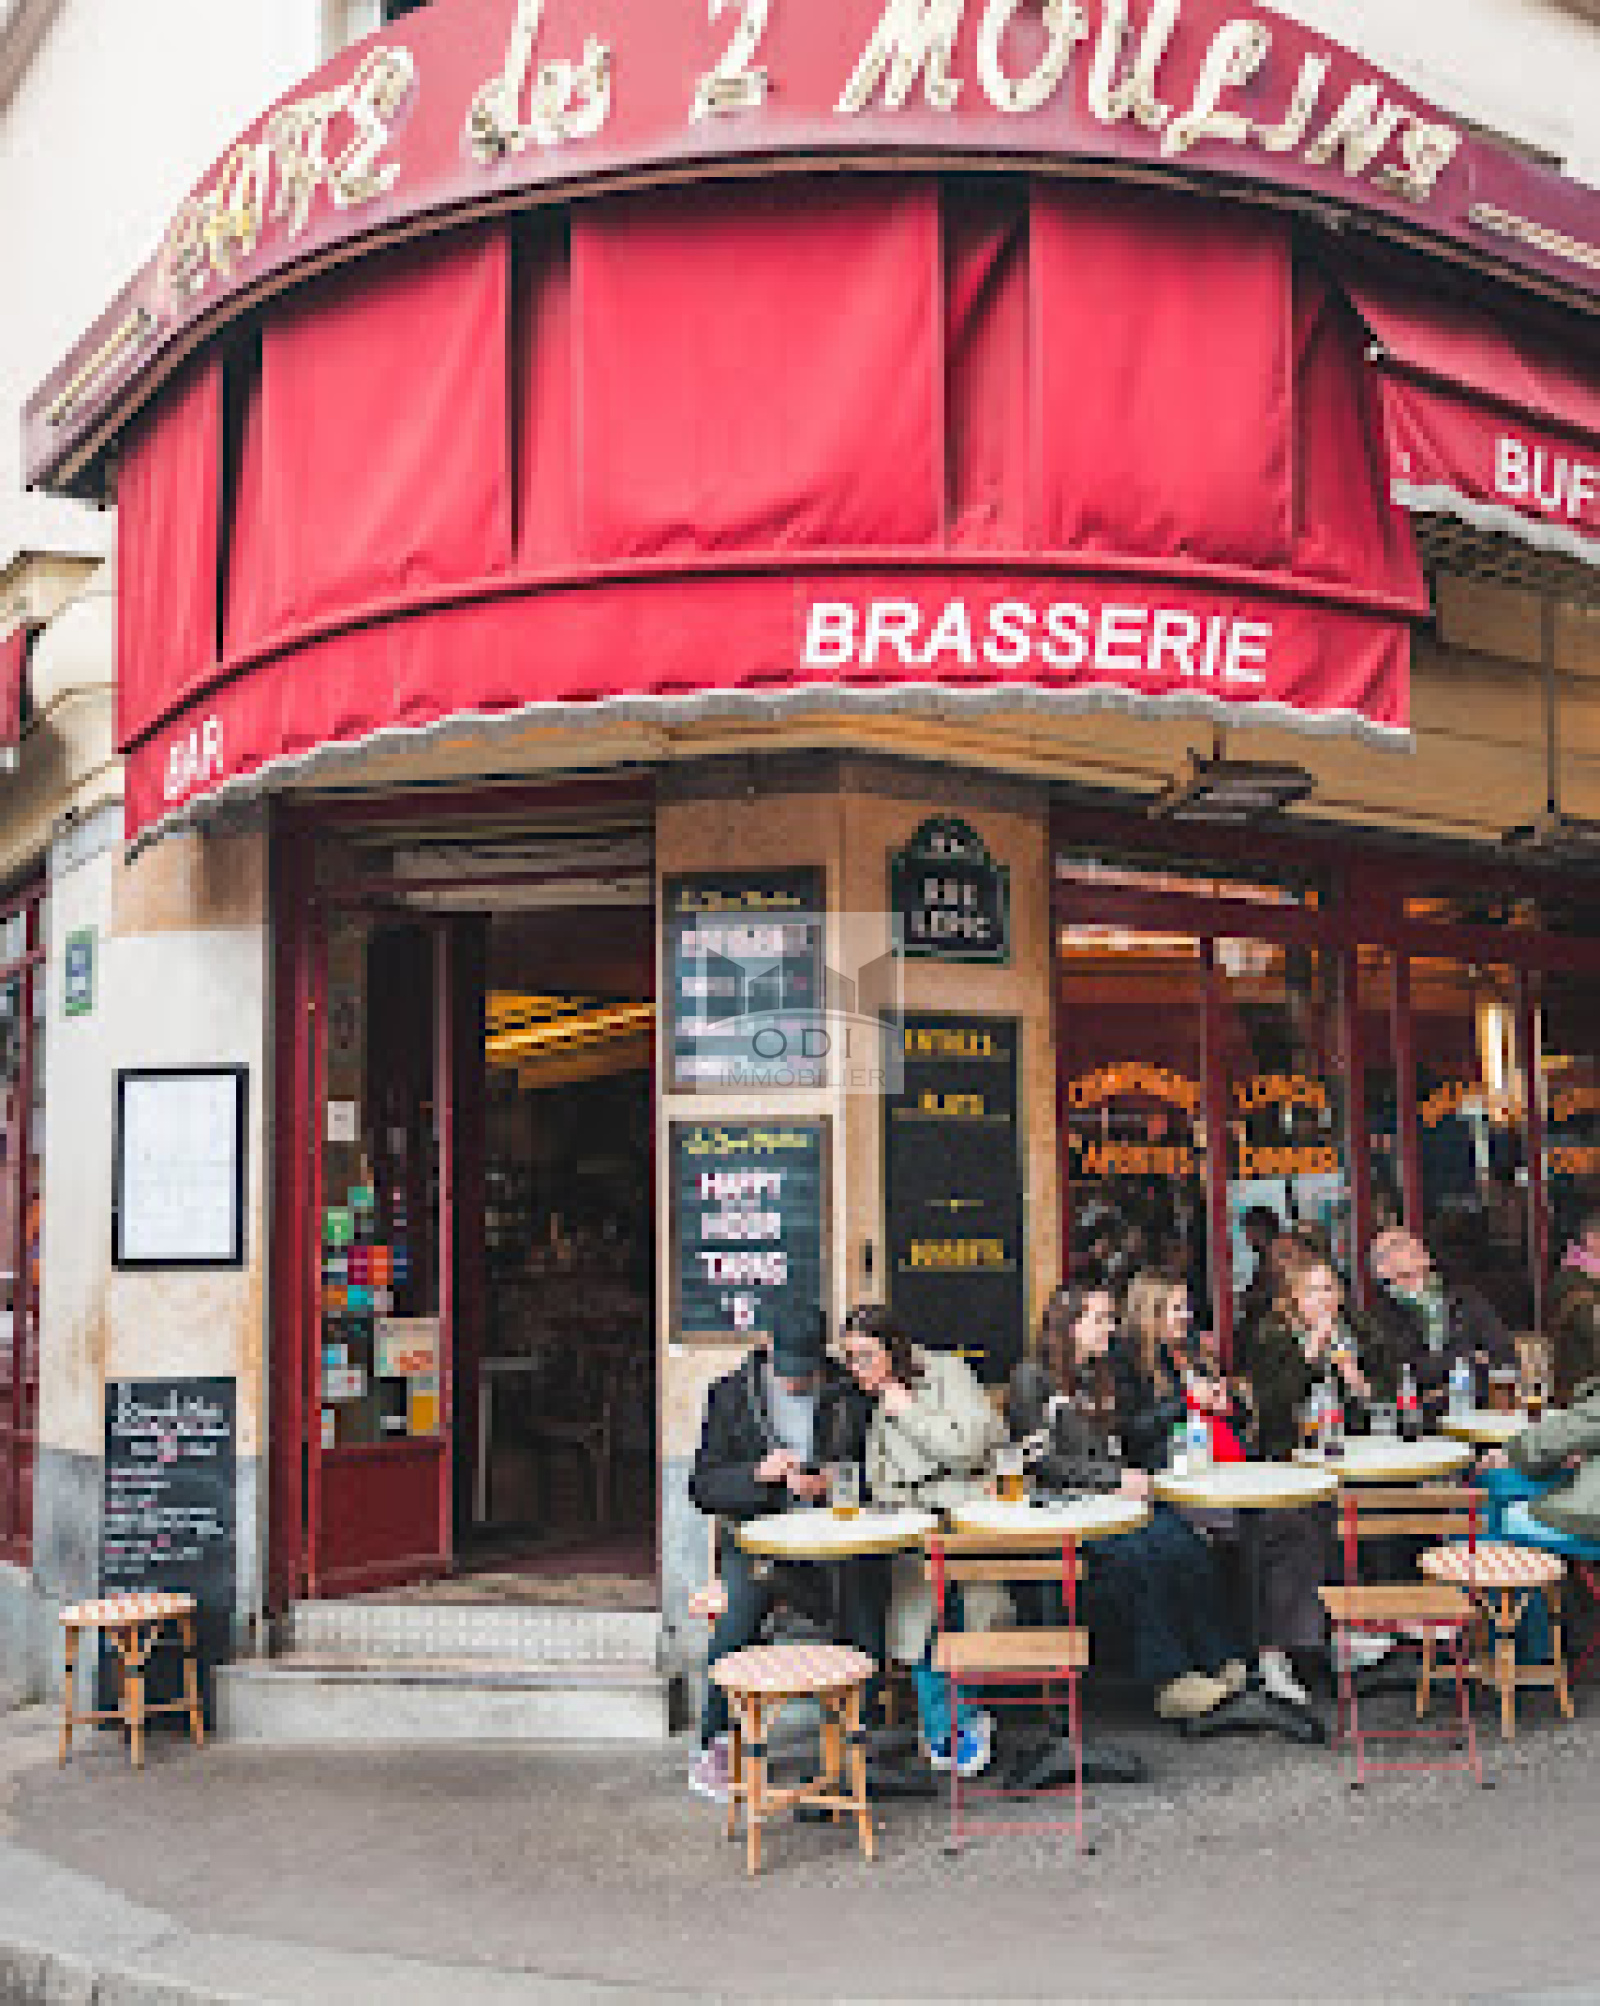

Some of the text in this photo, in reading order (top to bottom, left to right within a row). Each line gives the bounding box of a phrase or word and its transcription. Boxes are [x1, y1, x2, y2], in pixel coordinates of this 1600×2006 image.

[689, 0, 771, 124] 2
[832, 0, 1462, 201] MOULINS
[800, 596, 1272, 682] BRASSERIE
[164, 714, 224, 800] BAR
